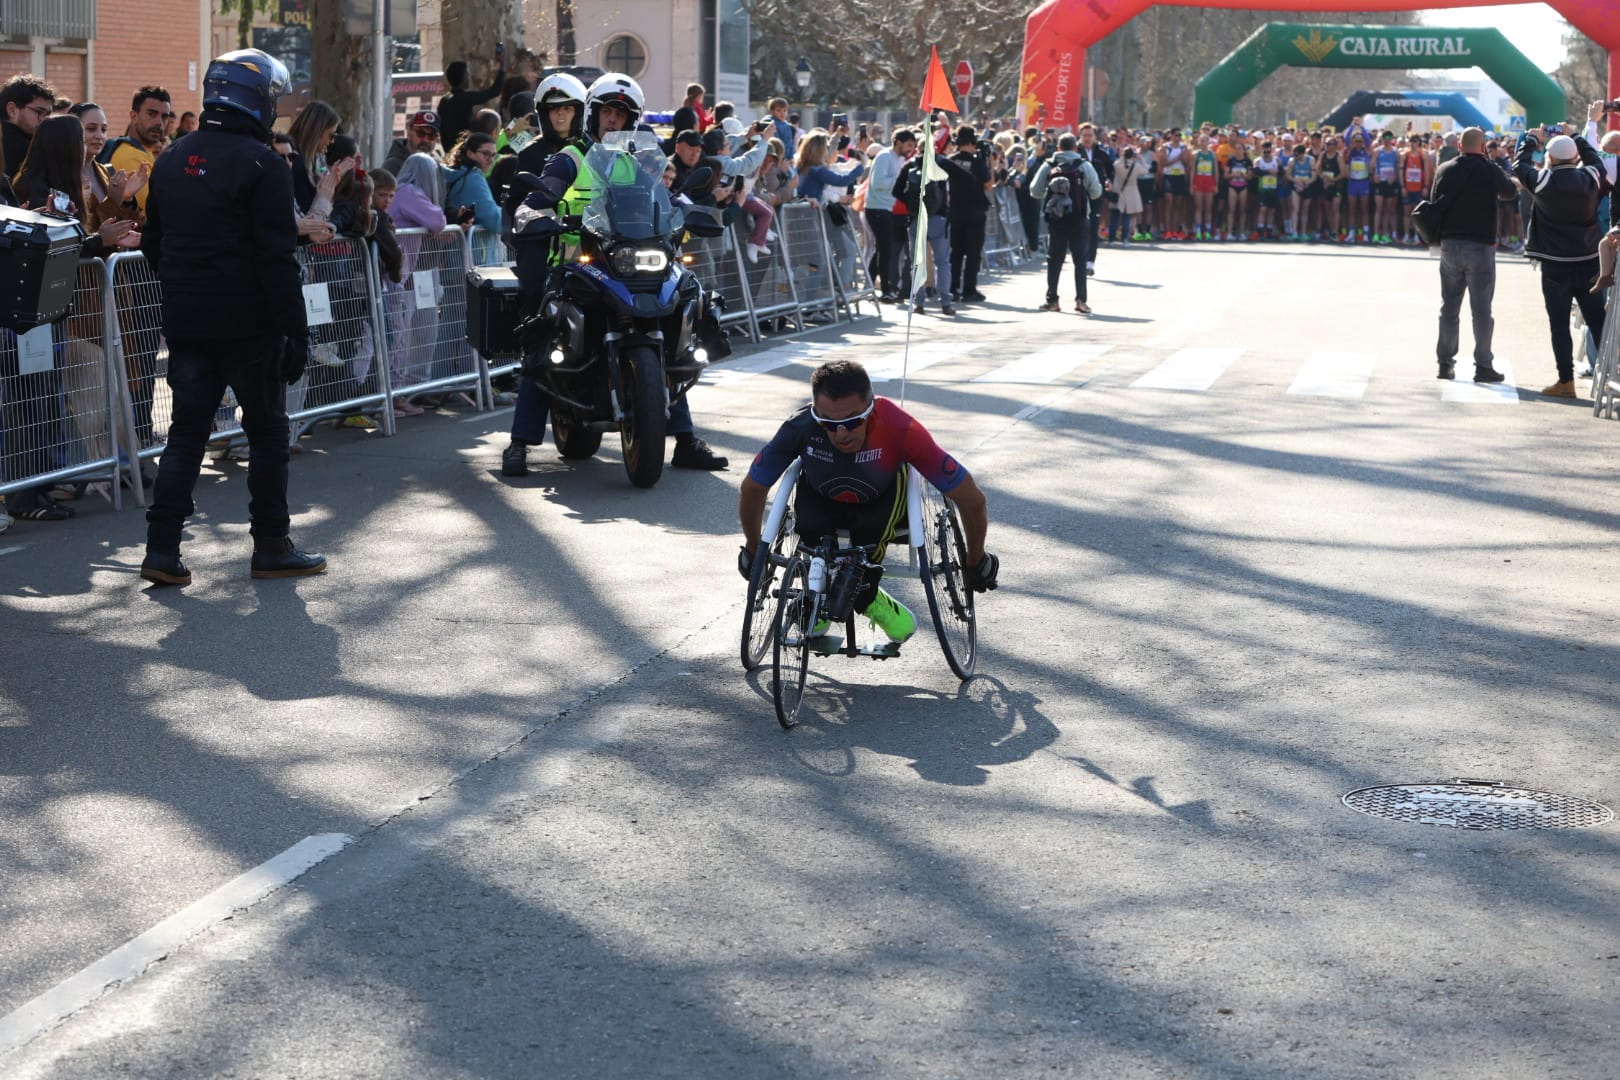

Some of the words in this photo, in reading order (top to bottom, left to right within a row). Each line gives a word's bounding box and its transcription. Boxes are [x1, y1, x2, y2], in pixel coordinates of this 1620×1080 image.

[1339, 36, 1393, 56] CAJA
[1394, 36, 1472, 56] RURAL
[1053, 52, 1073, 121] DEPORTES
